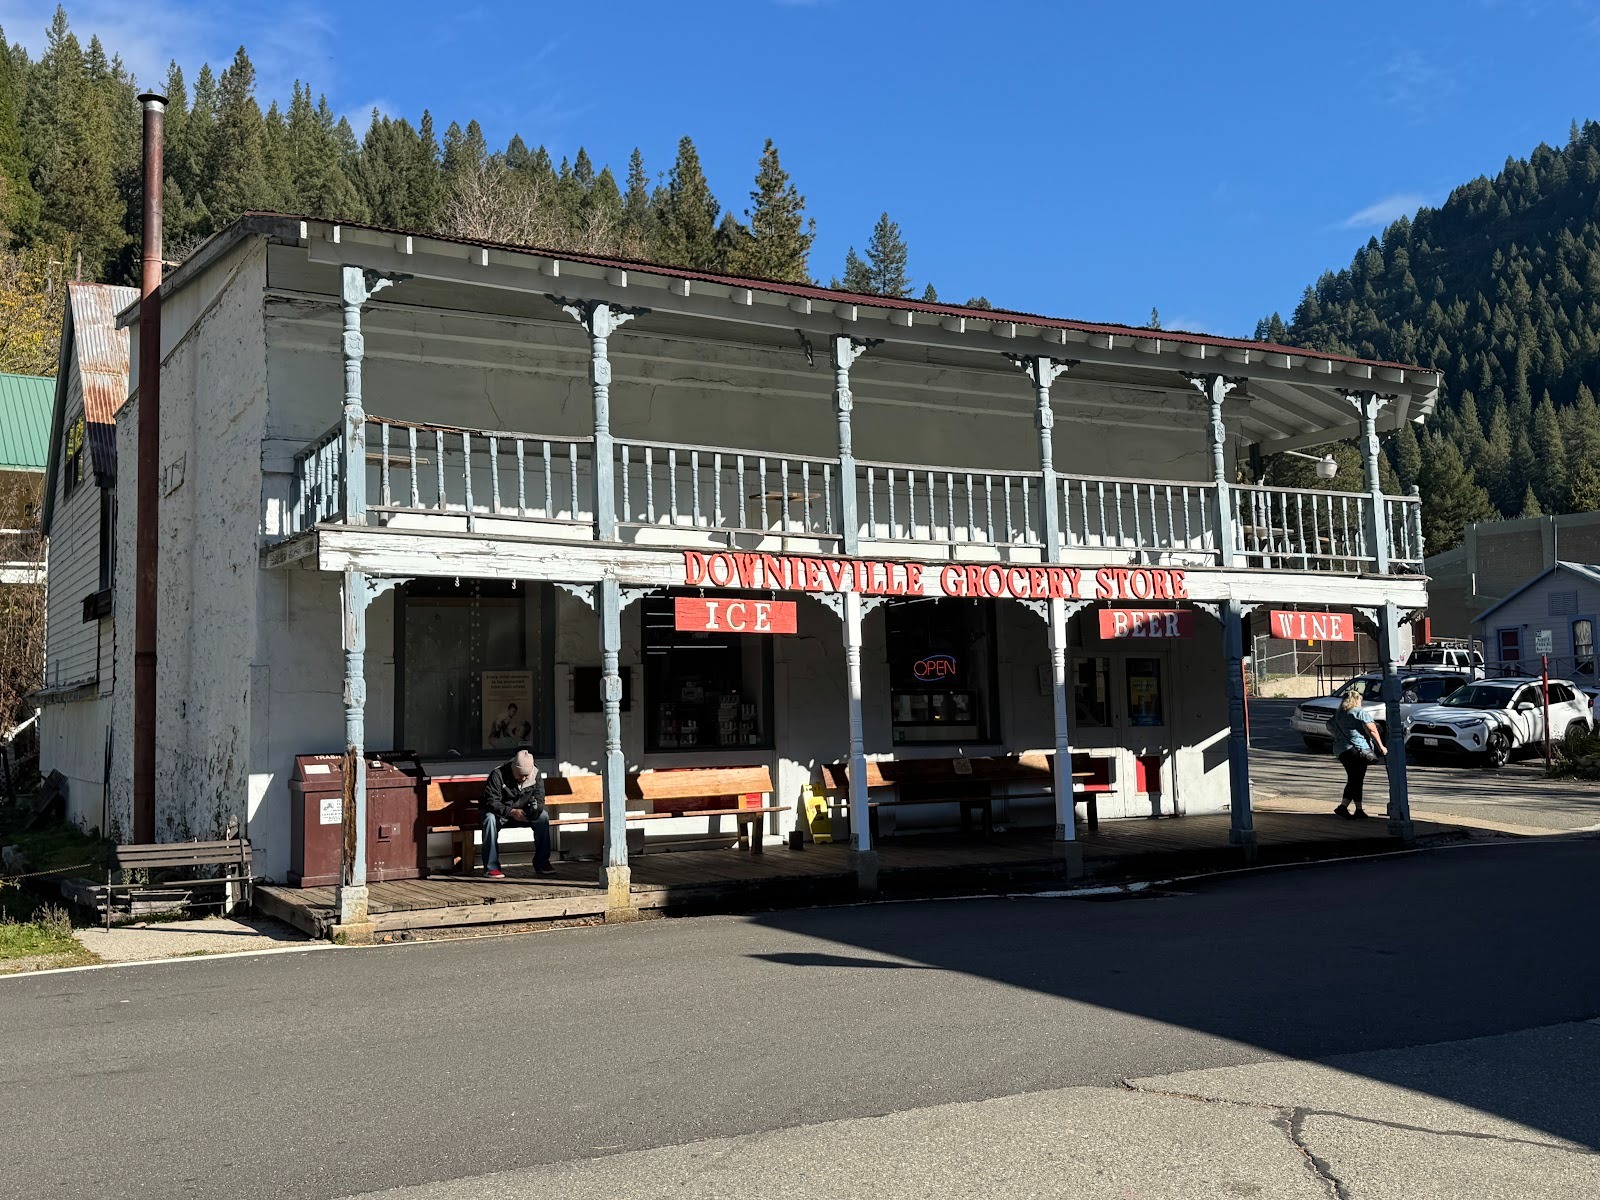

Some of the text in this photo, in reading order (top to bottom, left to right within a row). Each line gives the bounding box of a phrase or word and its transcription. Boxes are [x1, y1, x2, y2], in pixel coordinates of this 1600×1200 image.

[684, 551, 1189, 599] DOWNIEVILLE GROCERY STORE
[705, 601, 772, 631] ICE
[1113, 611, 1180, 638] BEER
[1277, 613, 1343, 640] WINE
[913, 660, 956, 676] OPEN
